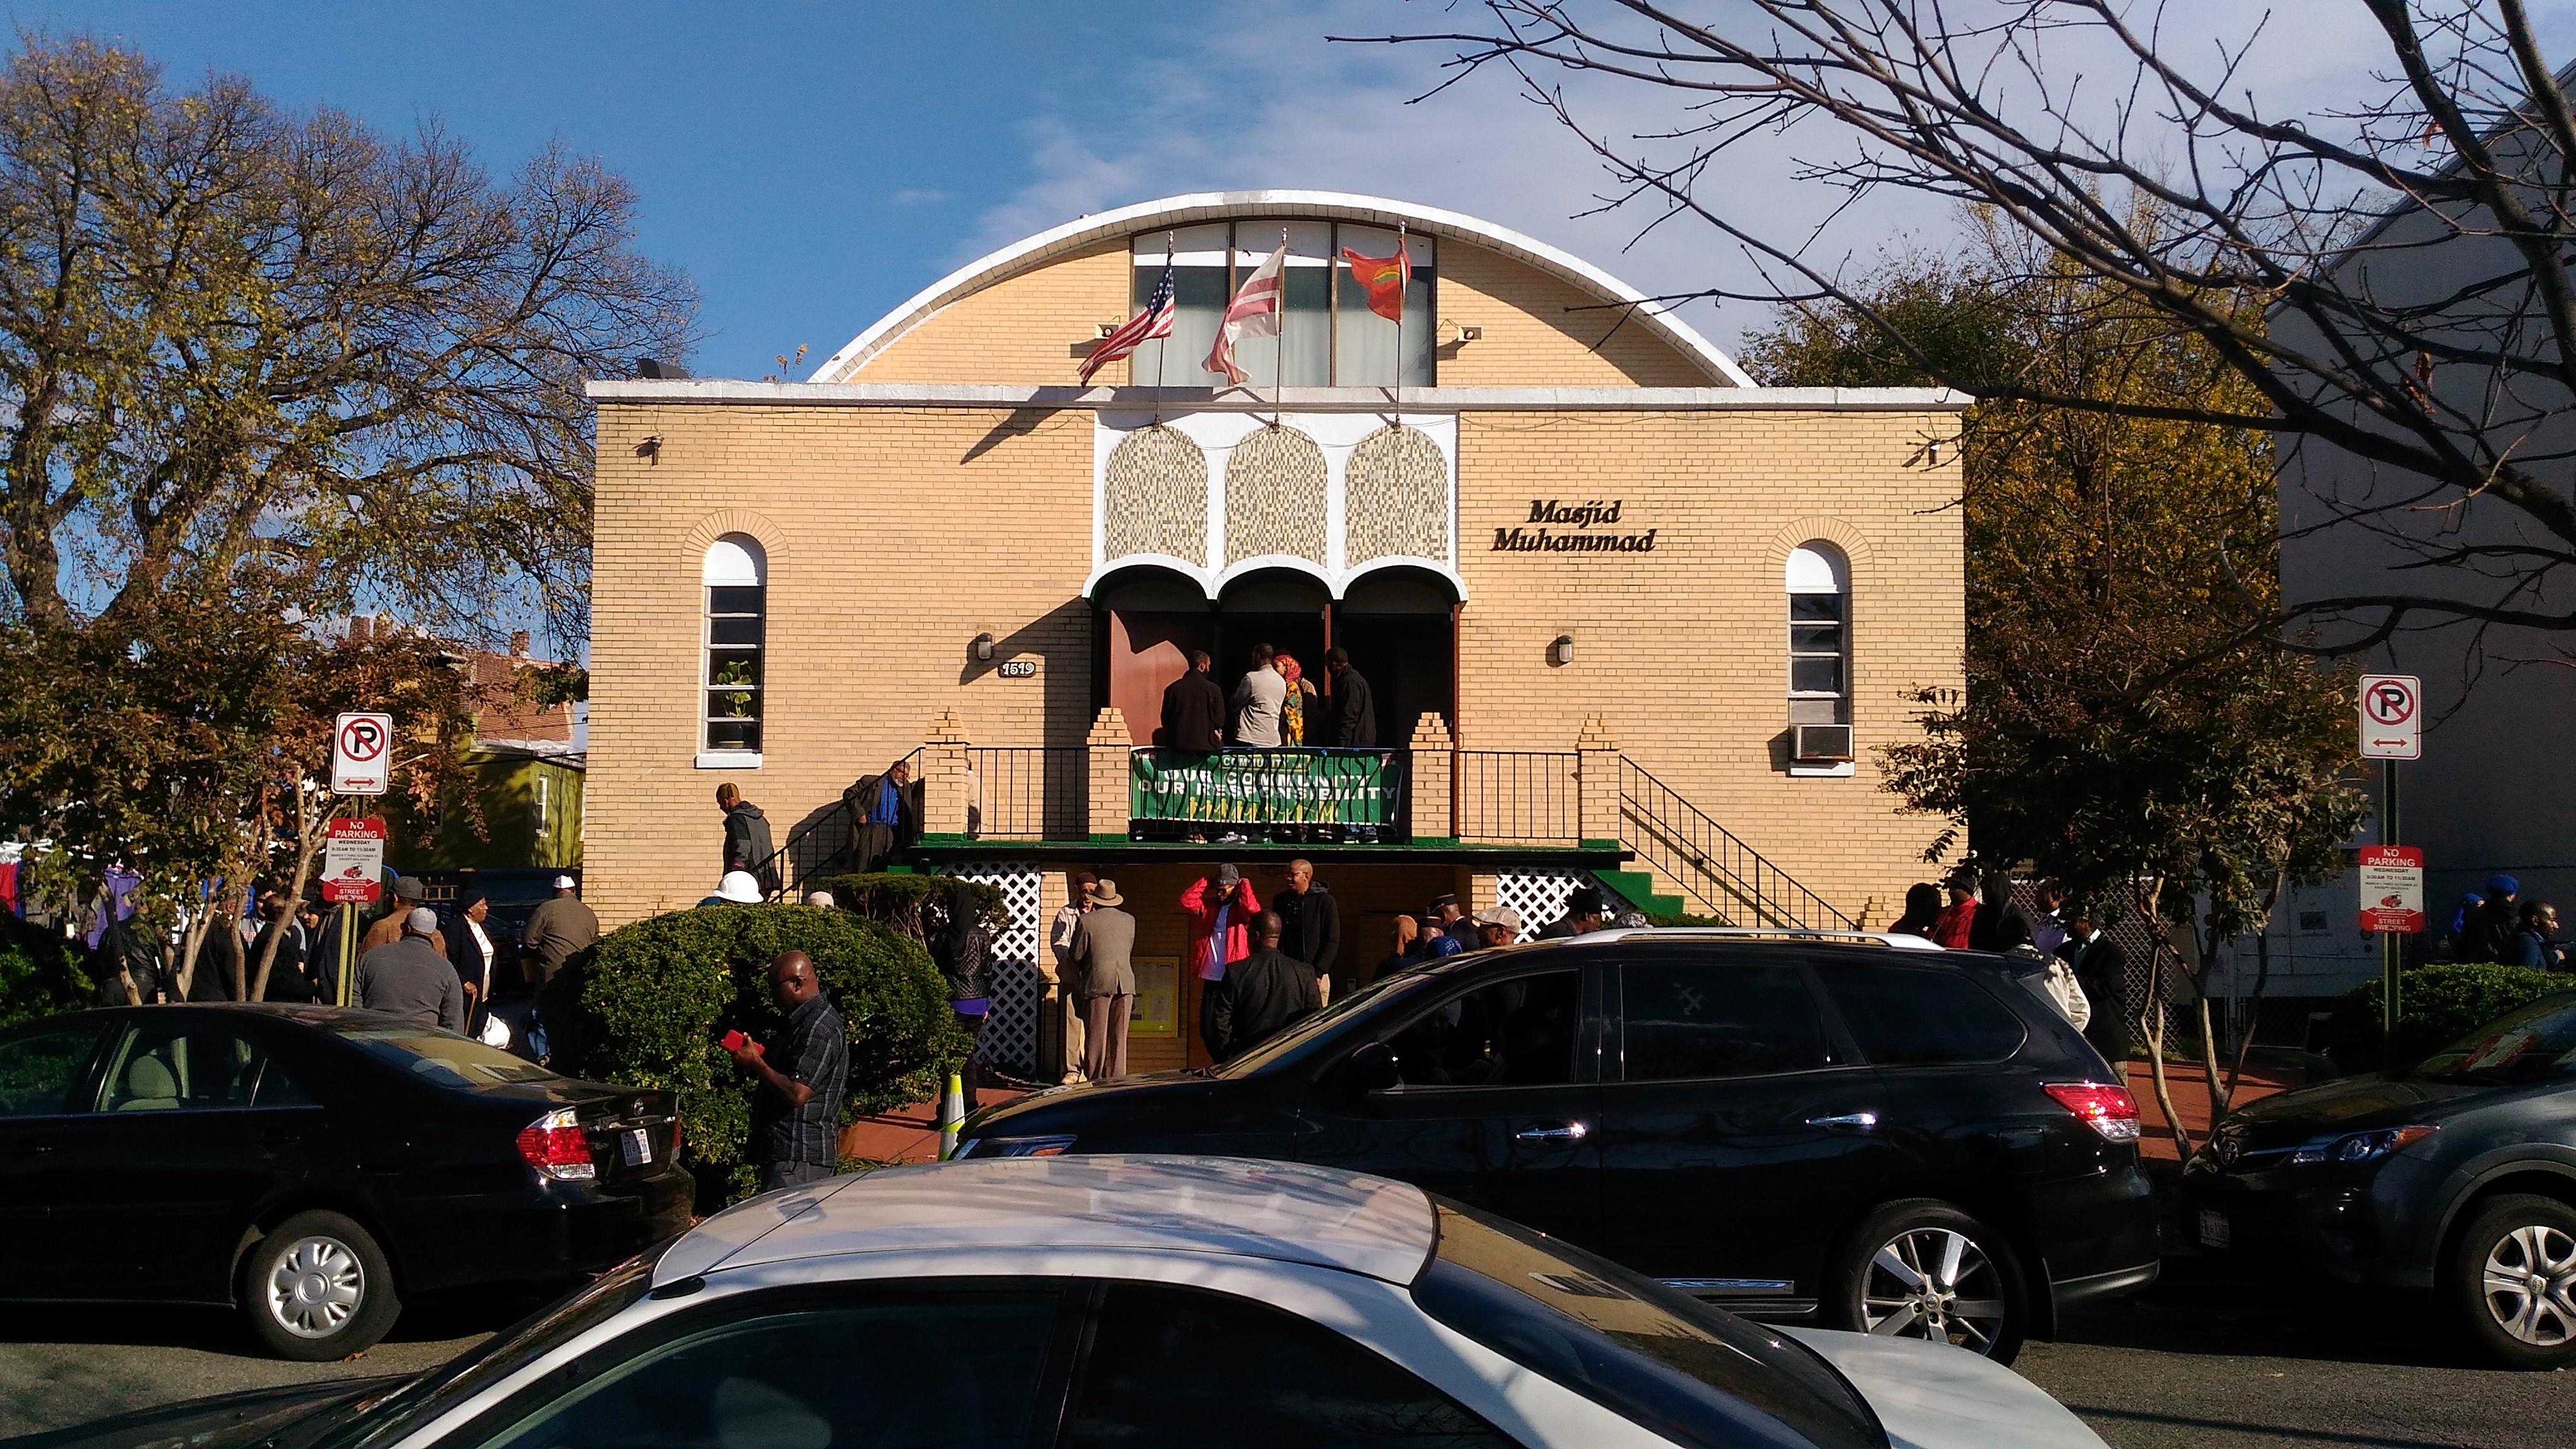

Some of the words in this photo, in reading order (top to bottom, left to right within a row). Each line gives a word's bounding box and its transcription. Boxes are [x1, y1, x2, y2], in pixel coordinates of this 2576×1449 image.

[1525, 499, 1623, 529] Masjid
[1489, 528, 1658, 552] Muhammad
[1002, 662, 1035, 675] 1519
[1164, 769, 1213, 783] OUR
[1226, 772, 1371, 787] COMMUNITY
[1138, 779, 1185, 794] OUR
[1196, 783, 1397, 801] RESPONSIBILITY
[350, 821, 365, 830] NO
[335, 830, 377, 838] PARKING
[2384, 848, 2399, 857] NO
[2368, 857, 2416, 867] PARKING
